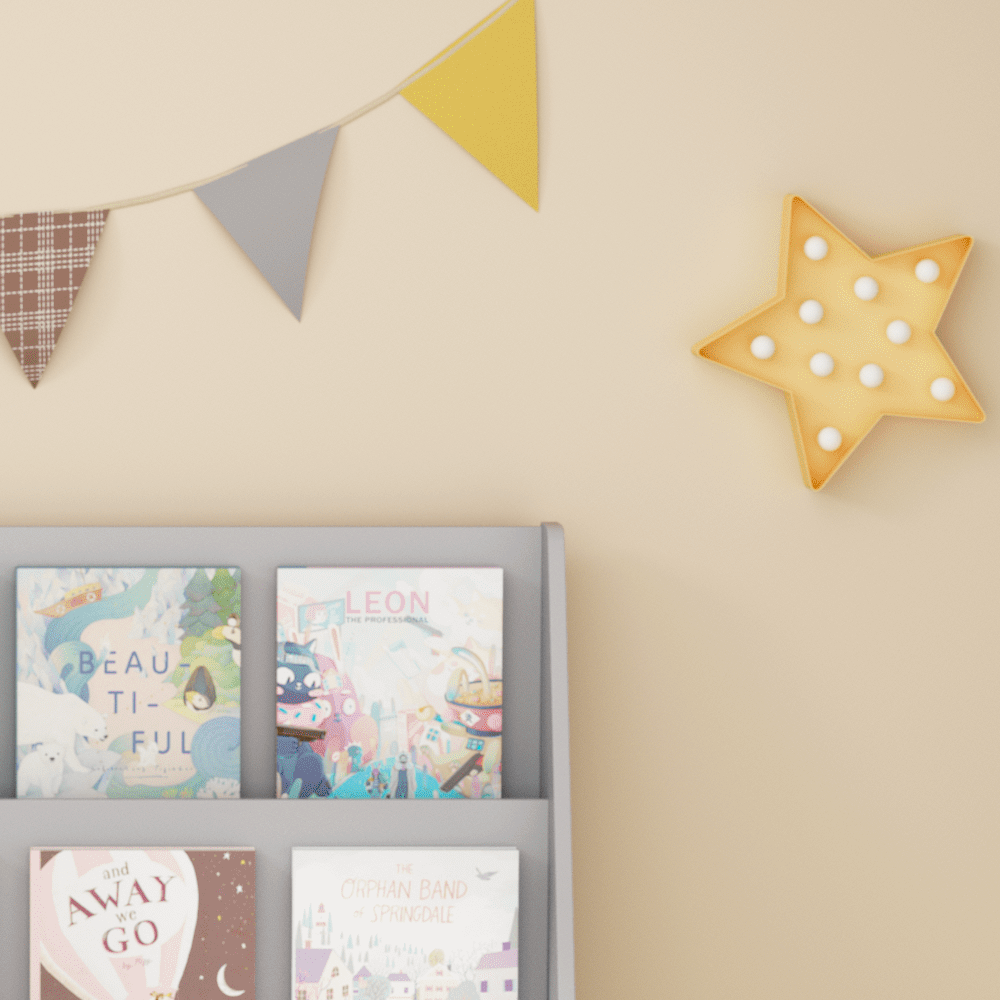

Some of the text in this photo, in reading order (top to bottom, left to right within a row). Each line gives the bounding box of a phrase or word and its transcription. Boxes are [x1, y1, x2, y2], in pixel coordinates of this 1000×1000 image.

[346, 590, 429, 614] LEON
[346, 616, 429, 624] THE PROFESSIONAL
[132, 730, 192, 755] FUL
[102, 861, 130, 880] and
[396, 863, 414, 875] THE
[341, 878, 469, 900] ORPHAN BAND
[67, 875, 177, 927] AWAY
[115, 909, 138, 923] we
[353, 904, 455, 924] of SPRINGDALE
[101, 919, 160, 954] GO
